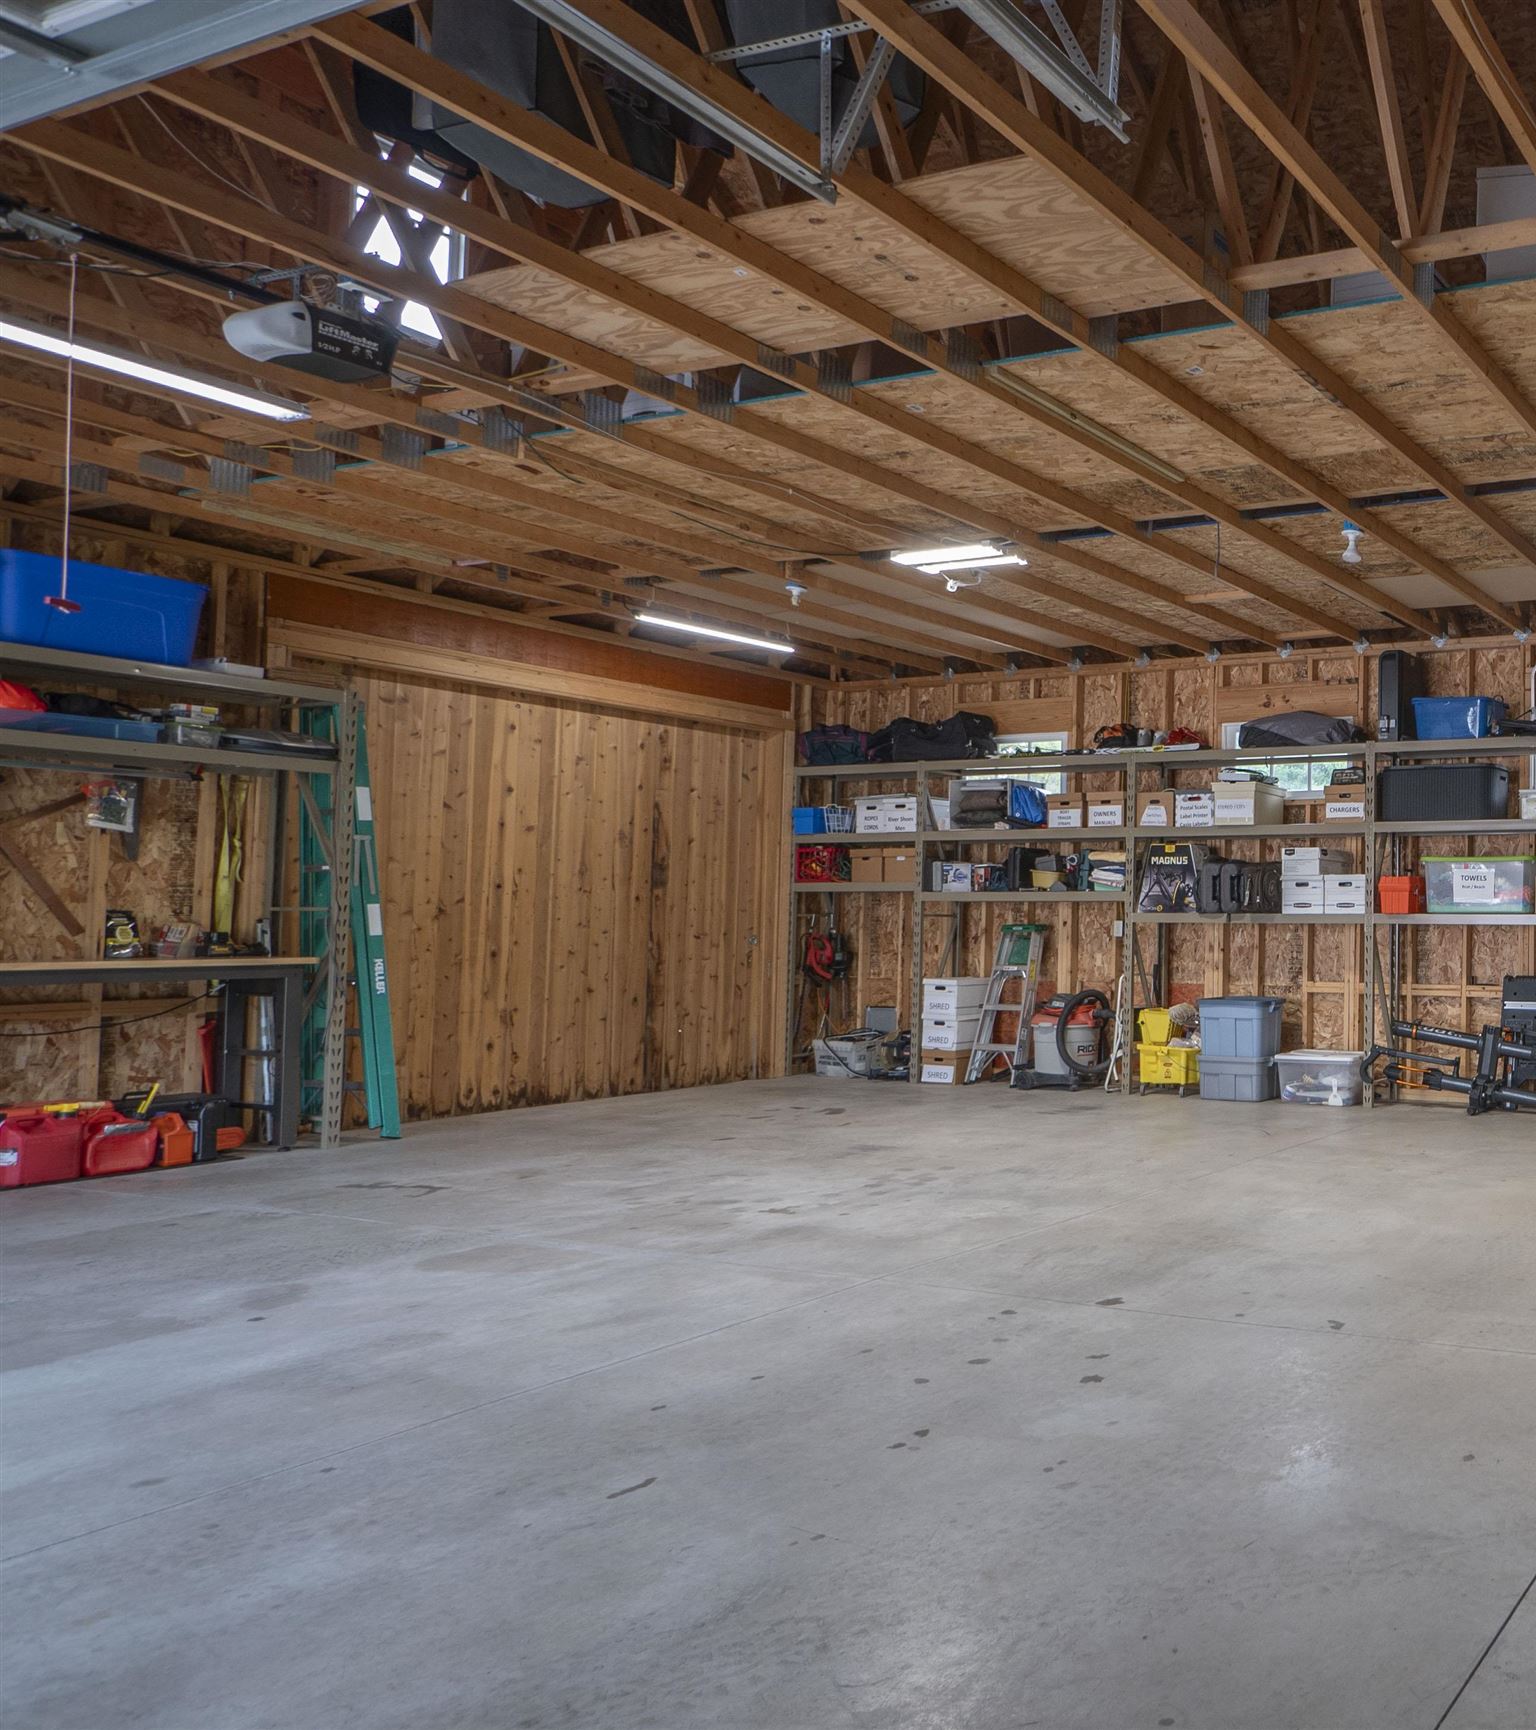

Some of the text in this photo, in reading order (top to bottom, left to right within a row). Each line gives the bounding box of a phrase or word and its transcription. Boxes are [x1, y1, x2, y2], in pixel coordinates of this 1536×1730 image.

[319, 322, 379, 347] LiftMaster
[1151, 856, 1188, 865] MAGNUS
[373, 958, 386, 995] KELLER
[929, 1002, 950, 1010] SHRED
[927, 1036, 949, 1044] SHRED
[927, 1071, 948, 1079] SHRED
